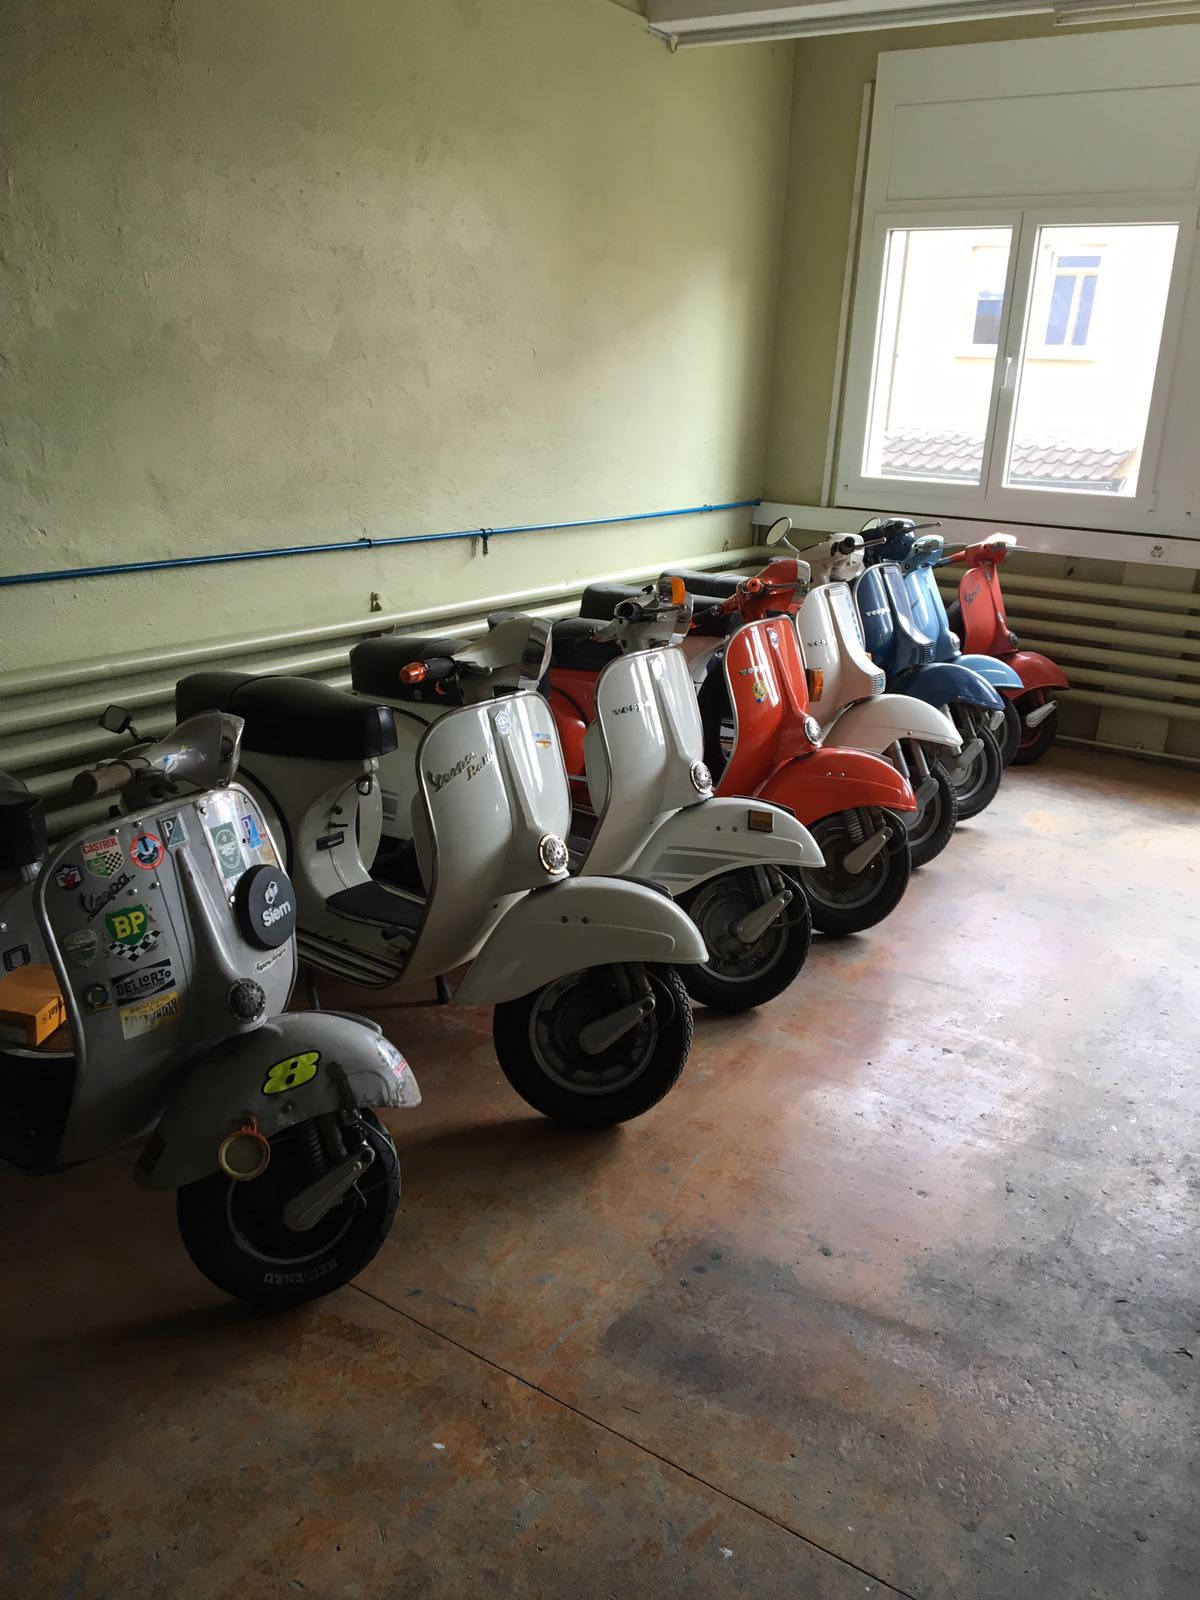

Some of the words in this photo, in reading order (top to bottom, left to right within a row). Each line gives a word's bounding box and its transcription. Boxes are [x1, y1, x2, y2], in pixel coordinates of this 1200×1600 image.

[82, 837, 118, 855] CASTROL
[113, 911, 146, 939] BP
[262, 901, 292, 927] Siem
